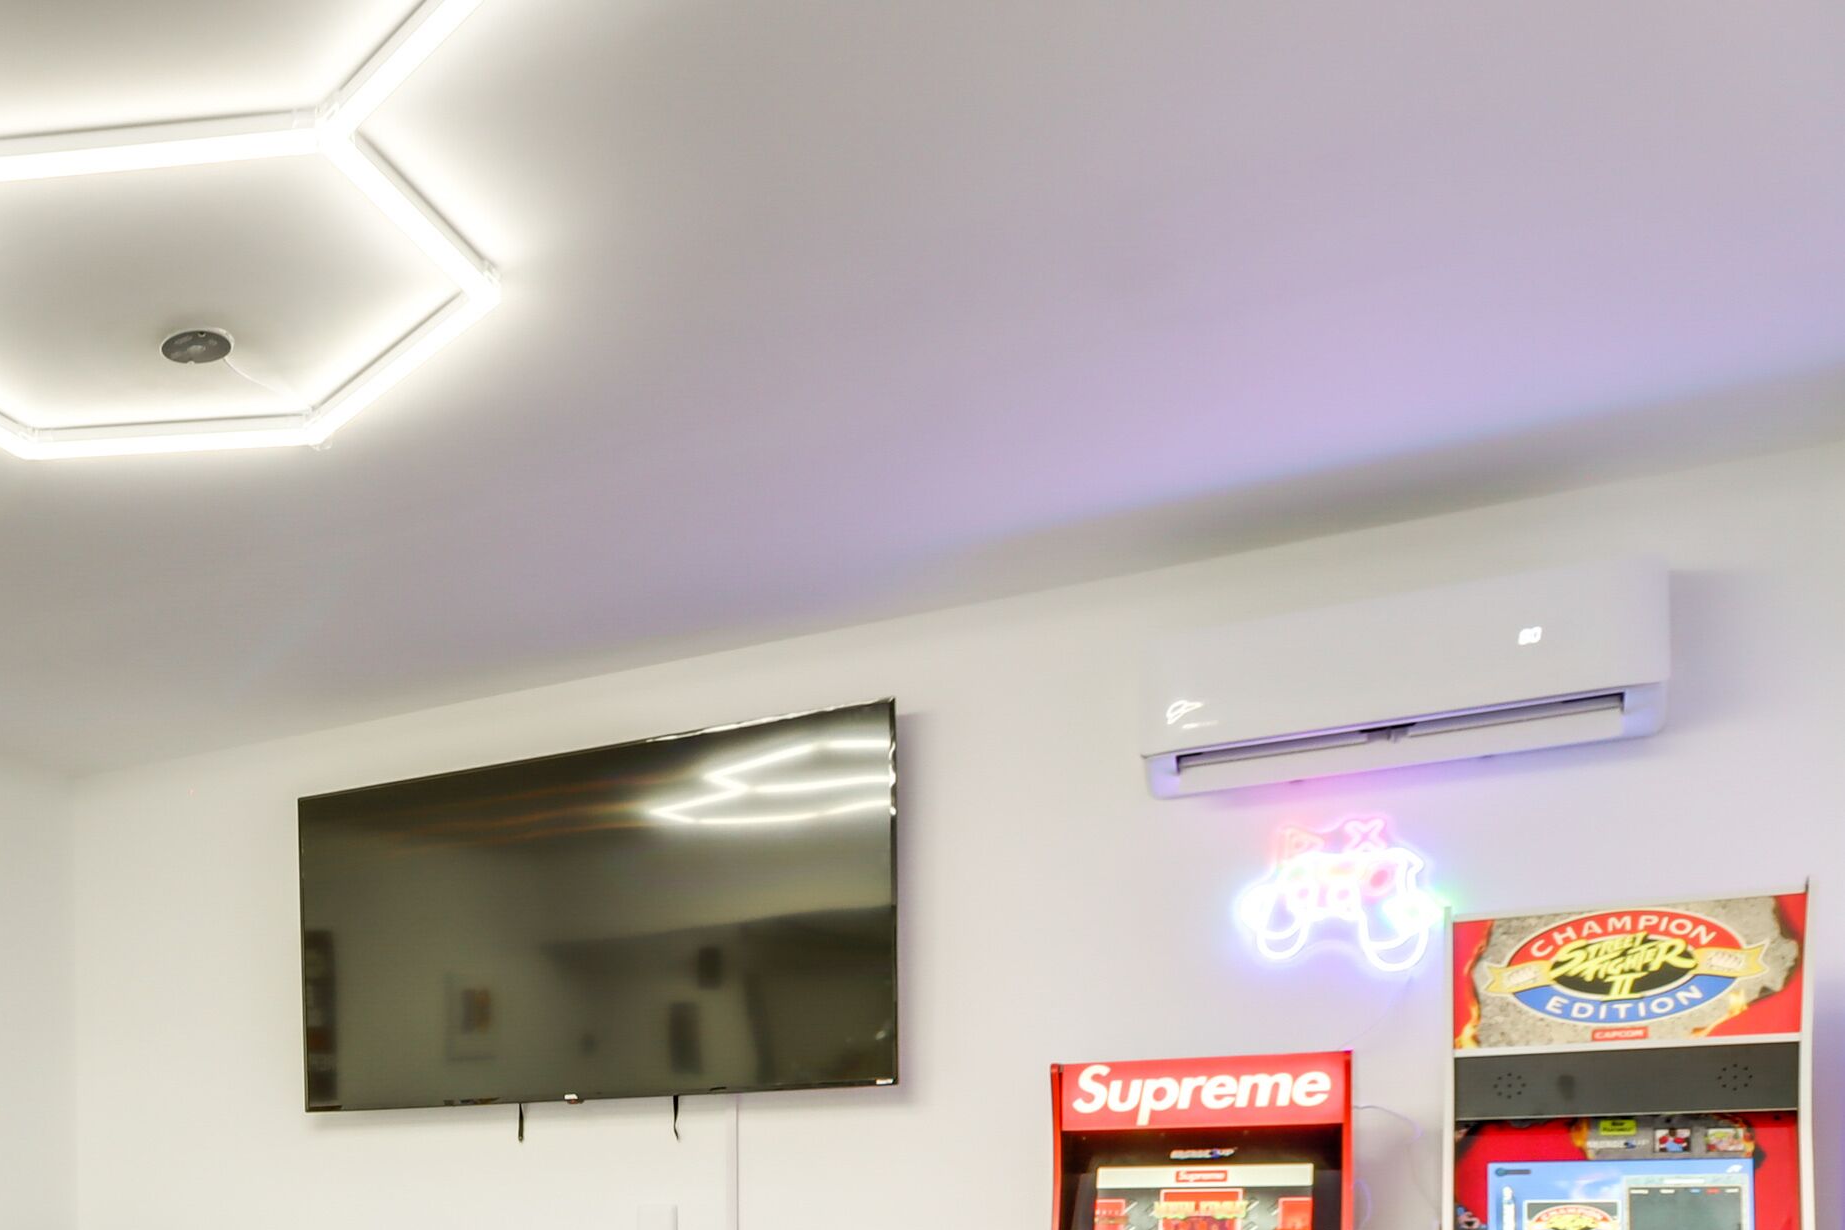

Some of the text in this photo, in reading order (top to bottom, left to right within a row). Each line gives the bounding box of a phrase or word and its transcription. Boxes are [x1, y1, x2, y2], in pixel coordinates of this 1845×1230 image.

[1530, 914, 1716, 958] CHAMPION
[1549, 931, 1648, 981] STREET
[1563, 937, 1698, 983] FIGHTER
[1544, 984, 1703, 1020] EDITION
[1072, 1065, 1332, 1127] Supreme
